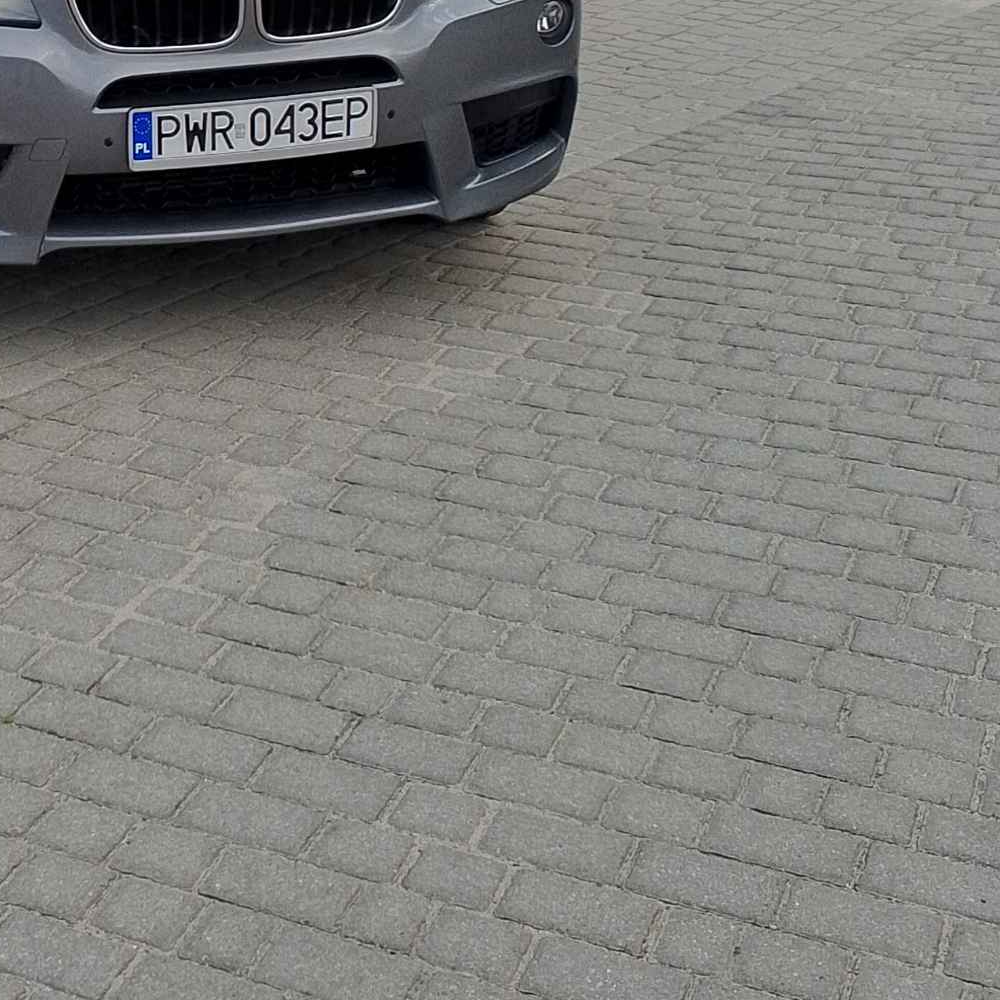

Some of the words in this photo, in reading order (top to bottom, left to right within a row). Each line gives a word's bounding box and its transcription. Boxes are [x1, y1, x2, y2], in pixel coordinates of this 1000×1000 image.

[156, 110, 235, 156] PWR
[249, 96, 369, 148] 043EP
[134, 142, 151, 155] PL
